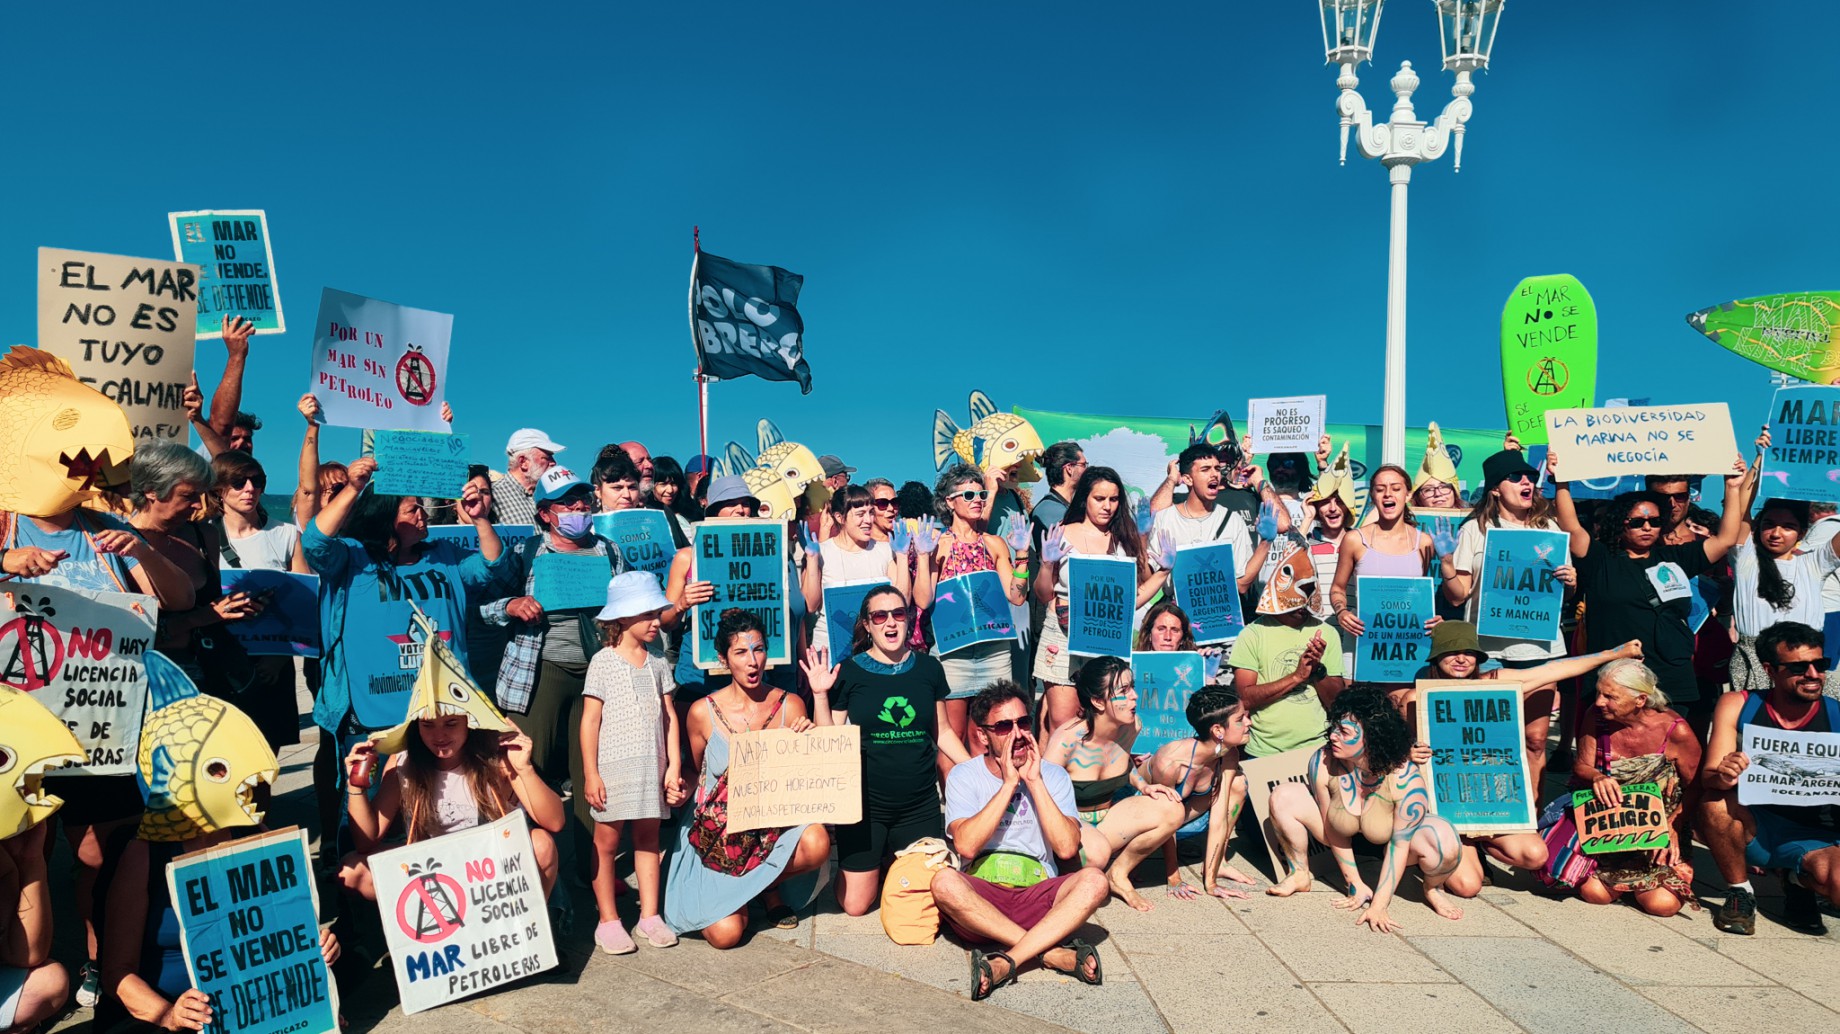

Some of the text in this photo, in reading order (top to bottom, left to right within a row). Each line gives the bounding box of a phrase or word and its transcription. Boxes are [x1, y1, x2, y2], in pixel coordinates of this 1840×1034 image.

[184, 221, 257, 243] EL MAR
[214, 244, 236, 260] NO
[59, 261, 196, 302] EL MAR
[211, 284, 272, 311] DEFIENDE
[1521, 285, 1571, 305] EL MAR
[62, 303, 179, 332] NO ES
[1562, 305, 1579, 317] SE
[1754, 296, 1833, 333] MAR
[330, 322, 383, 348] POR UN
[1517, 324, 1579, 349] VENDE
[79, 339, 164, 366] TUYO
[328, 349, 386, 379] MAR SIN
[320, 372, 393, 410] PETROLEO
[1515, 402, 1530, 416] SE
[1553, 409, 1706, 429] LA BIODIVERSIDAD
[1264, 415, 1310, 426] PROGRESO
[1273, 426, 1302, 434] SAQUEO
[447, 437, 463, 454] NO
[1575, 430, 1695, 447] MARINA NO SE
[1786, 428, 1838, 446] LIBRE
[1772, 447, 1840, 466] SIEMPR
[620, 531, 652, 544] SOMOS
[703, 532, 776, 558] EL MAR
[641, 559, 667, 571] MISMO
[1499, 550, 1511, 562] EL
[729, 561, 751, 580] NO
[1187, 570, 1225, 586] FUERA
[1493, 566, 1555, 593] MAR
[376, 568, 451, 603] MTR
[1084, 582, 1124, 604] MAR
[1189, 584, 1228, 598] EQUINOR
[1190, 593, 1229, 608] DEL MAR
[1381, 601, 1411, 610] SOMOS
[1514, 595, 1530, 605] NO
[1084, 601, 1123, 621] LIBRE
[1193, 605, 1231, 616] ARGENTINO
[1373, 612, 1420, 629] AGUA
[1490, 607, 1550, 621] SE MANCHA
[701, 610, 716, 640] SE
[1083, 626, 1122, 640] PETROLEO
[67, 626, 149, 661] NO HAY
[1395, 632, 1423, 640] MISMO
[1371, 642, 1418, 660] MAR
[63, 663, 138, 684] LICENCIA
[1143, 673, 1155, 684] EL
[368, 672, 414, 696] Movimiento
[64, 688, 127, 708] SOCIAL
[1160, 715, 1176, 724] NO
[1435, 699, 1511, 723] EL MAR
[90, 721, 112, 740] DE
[1462, 727, 1485, 745] NO
[734, 740, 768, 768] NADA
[776, 740, 800, 755] QUE
[802, 734, 852, 756] IRRUMPA
[1752, 737, 1800, 754] FUERA
[1434, 749, 1454, 766] SE
[733, 777, 847, 798] NUESTRO HORIZONTE
[1436, 772, 1522, 803] SE DEFIENDE
[1747, 774, 1767, 783] DEL
[1769, 775, 1796, 786] MAR
[1621, 794, 1650, 810] EN
[1585, 810, 1661, 835] PELIGRO
[465, 852, 521, 883] NO HAY
[185, 854, 298, 917] EL MAR
[470, 875, 530, 906] LICENCIA
[481, 898, 529, 924] SOCIAL
[228, 905, 264, 939] NO
[405, 922, 538, 983] MAR LIBRE DE
[196, 949, 227, 983] SE
[449, 954, 541, 995] PETROLERAS
[231, 957, 325, 1031] DEFIENDE
